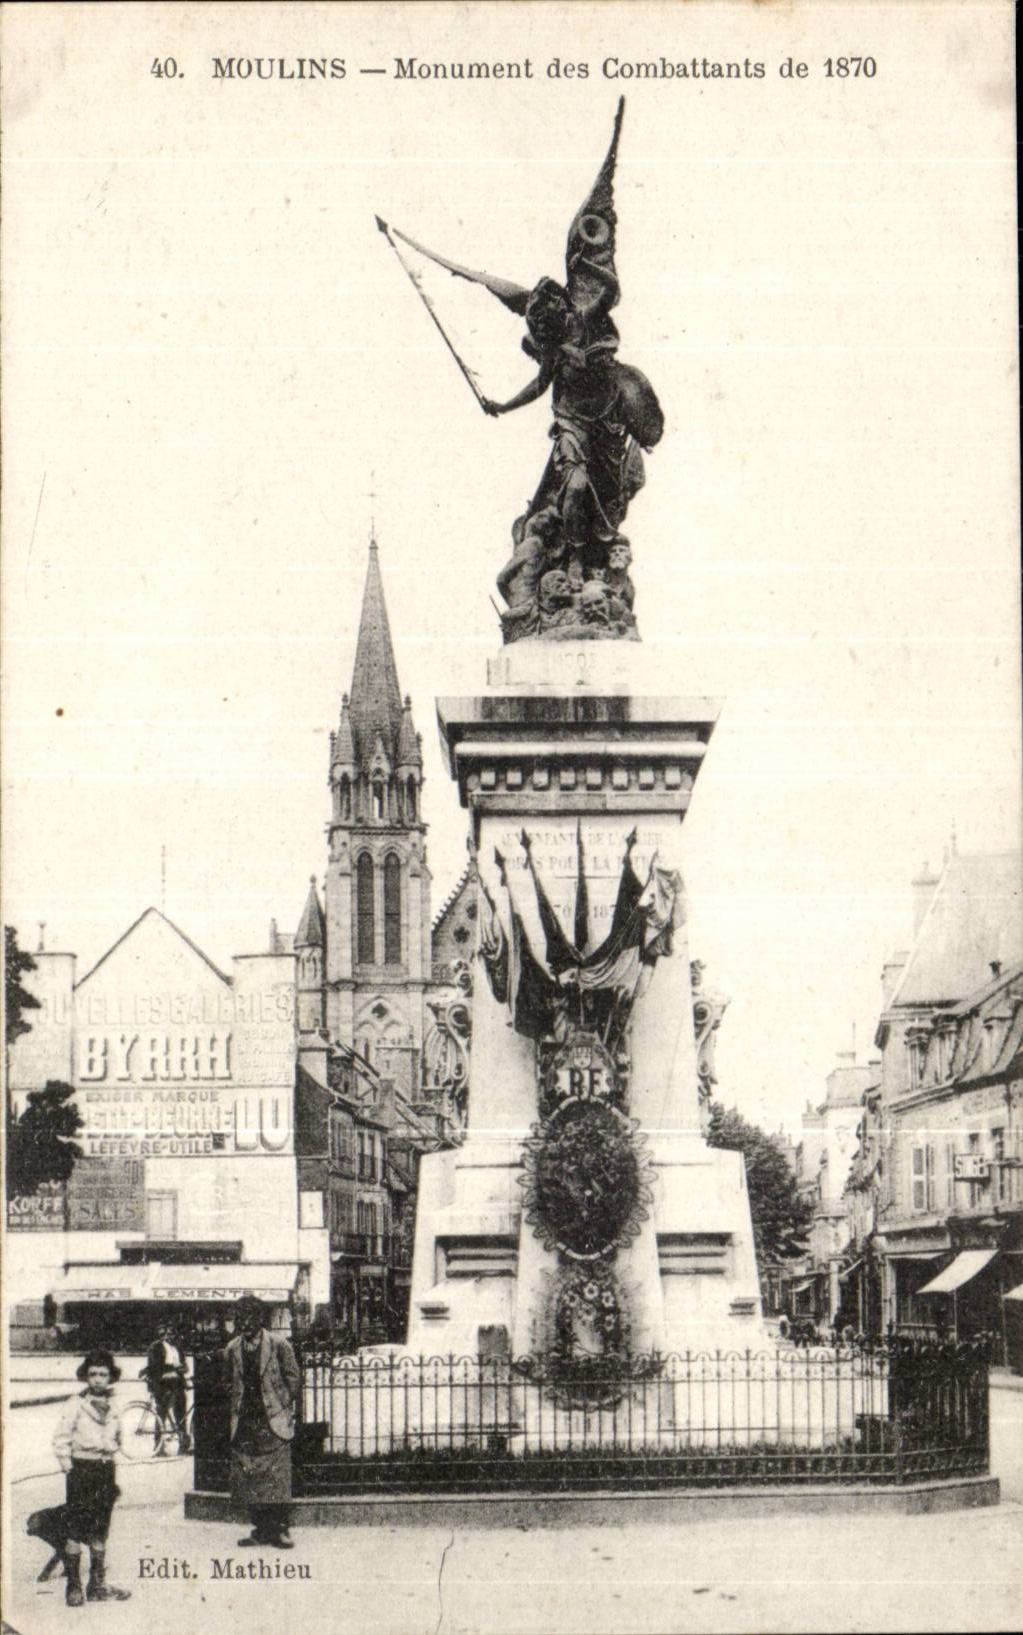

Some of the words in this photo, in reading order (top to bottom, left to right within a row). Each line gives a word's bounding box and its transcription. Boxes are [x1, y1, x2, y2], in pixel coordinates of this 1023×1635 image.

[79, 1031, 233, 1082] BYRRH
[152, 1090, 219, 1104] MARQUE
[234, 1096, 290, 1152] LU
